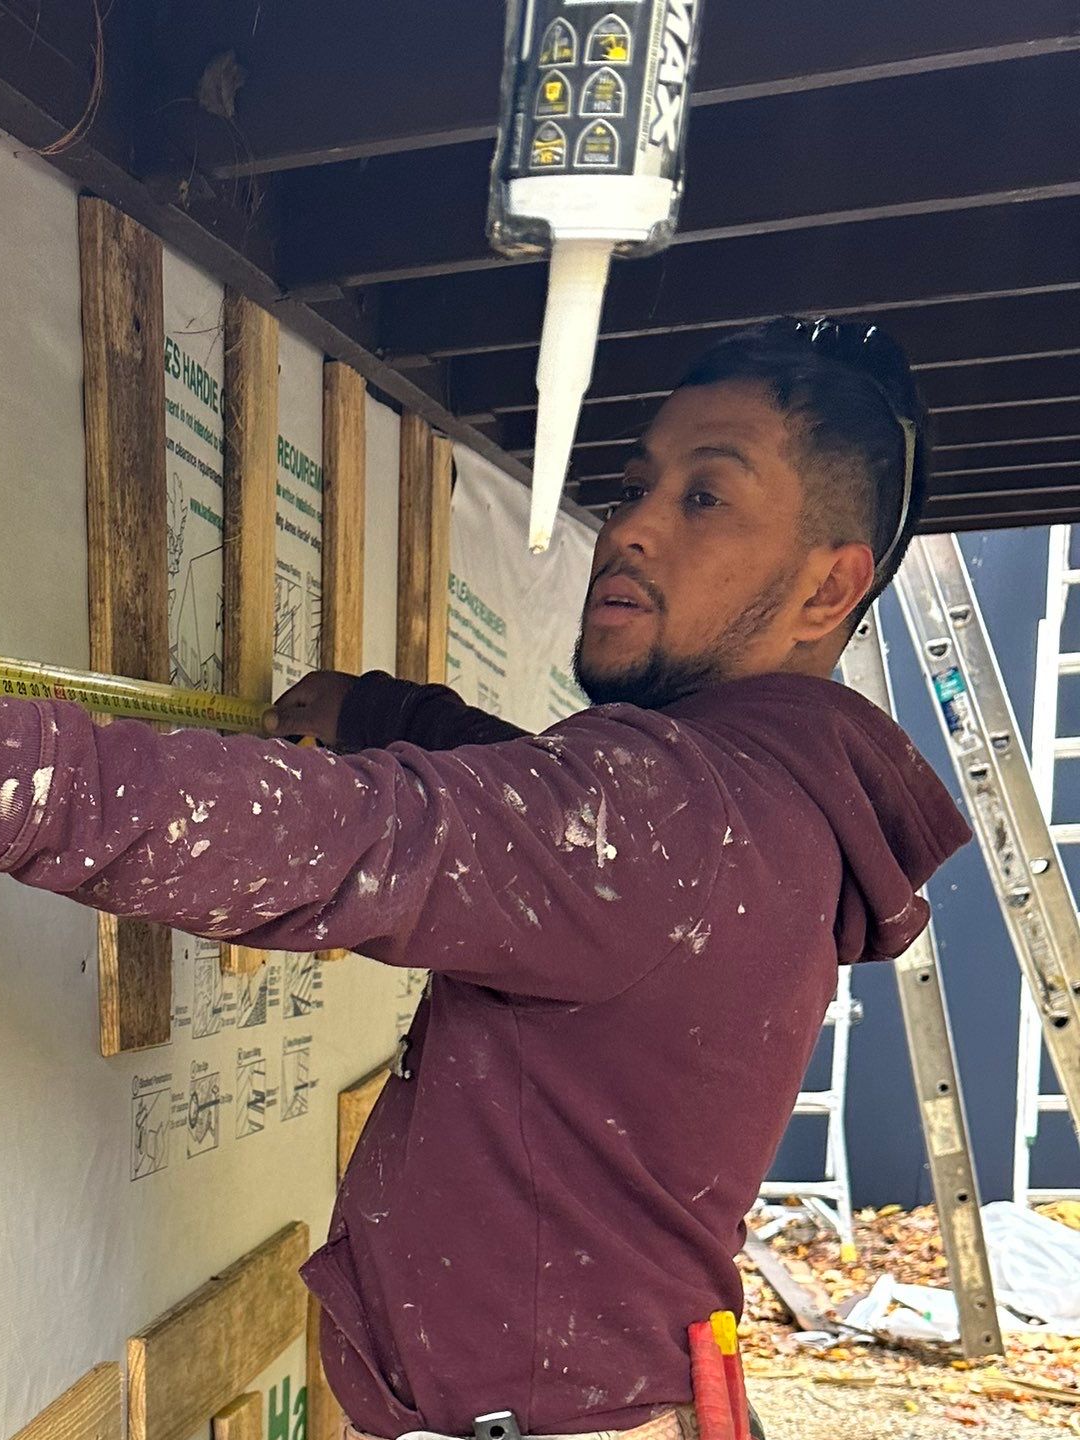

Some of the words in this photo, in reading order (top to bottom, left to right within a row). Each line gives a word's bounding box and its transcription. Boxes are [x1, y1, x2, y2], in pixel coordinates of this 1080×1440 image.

[182, 352, 219, 415] HARDIE
[2, 680, 14, 694] 28
[16, 682, 27, 696] 29
